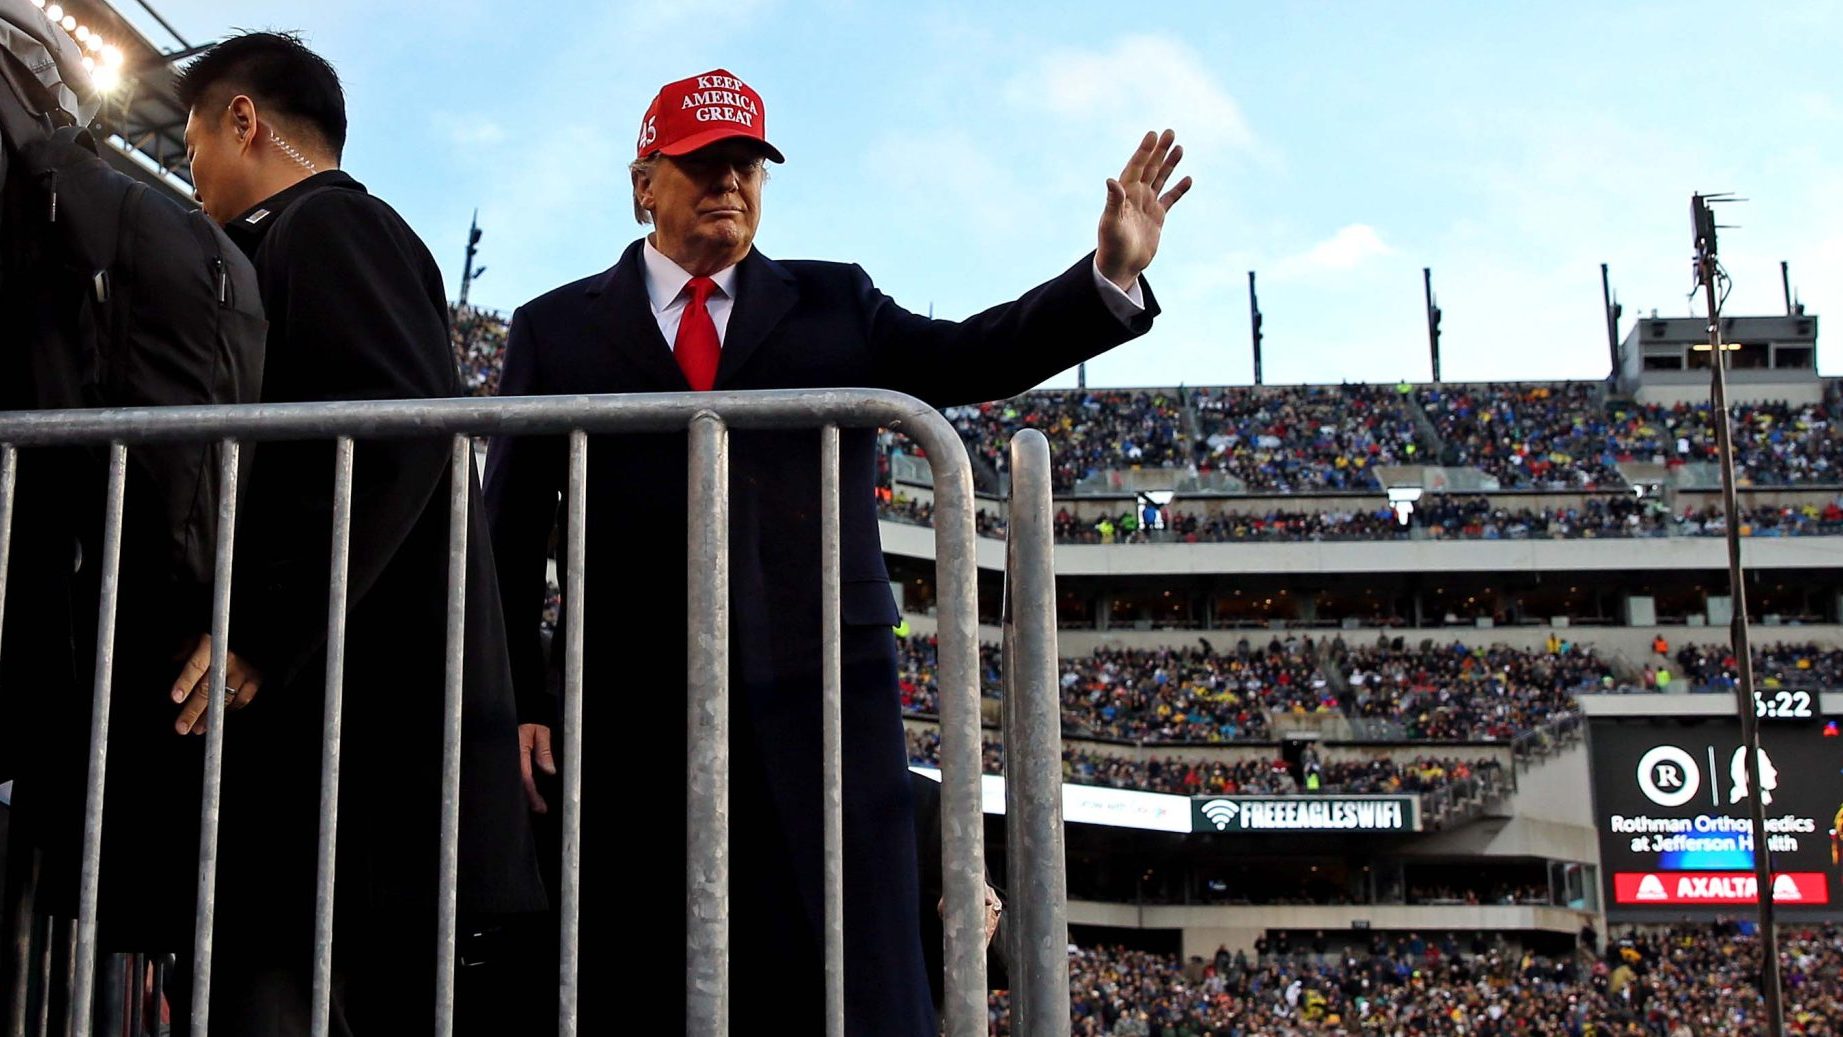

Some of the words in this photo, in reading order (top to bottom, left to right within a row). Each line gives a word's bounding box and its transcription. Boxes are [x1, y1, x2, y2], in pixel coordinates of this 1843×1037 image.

[697, 75, 743, 91] KEEP
[681, 90, 758, 116] AMERICA
[696, 106, 753, 127] GREAT
[639, 115, 657, 148] 45
[1656, 765, 1682, 787] R
[1240, 801, 1402, 829] FREEEAGLESWIFI
[1611, 815, 1691, 832] Rothman
[1631, 836, 1650, 852] at
[1652, 835, 1736, 852] Jefferson
[1738, 834, 1798, 852] Hlth
[1677, 876, 1758, 898] AXALTA
